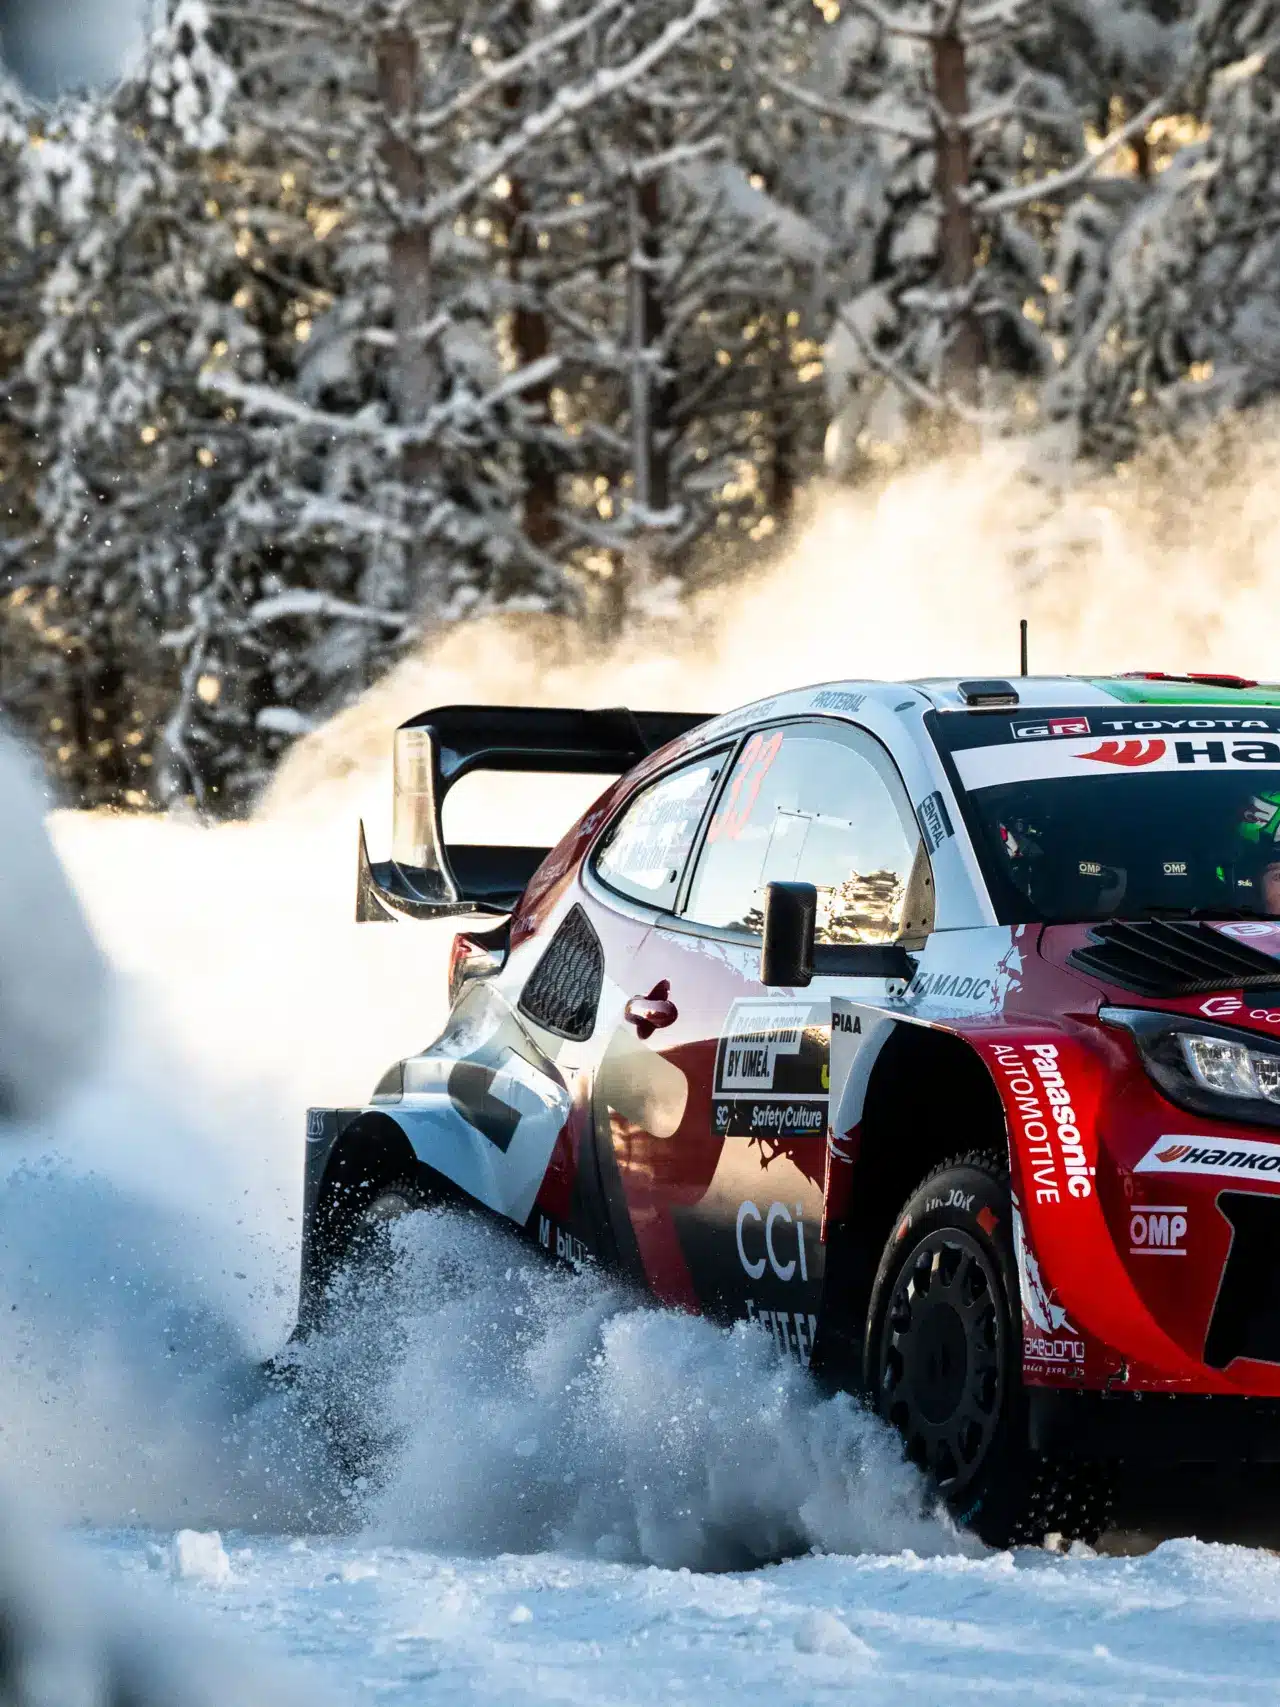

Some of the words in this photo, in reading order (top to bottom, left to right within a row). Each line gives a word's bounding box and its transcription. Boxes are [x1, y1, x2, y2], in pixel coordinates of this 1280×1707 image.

[1017, 722, 1088, 738] GR
[1102, 720, 1269, 730] TOYOTA
[922, 795, 945, 849] CENTRAL
[1079, 863, 1101, 875] OMP
[1163, 863, 1187, 874] OMP
[912, 972, 991, 1000] TAMADIC
[832, 1012, 862, 1035] PIAA
[727, 1050, 740, 1077] BY
[716, 1105, 729, 1125] SC
[751, 1105, 822, 1129] SafetyCulture
[989, 1044, 1061, 1204] AUTOMOTIVE
[1023, 1044, 1097, 1198] Panasonic
[1130, 1213, 1188, 1247] OMP
